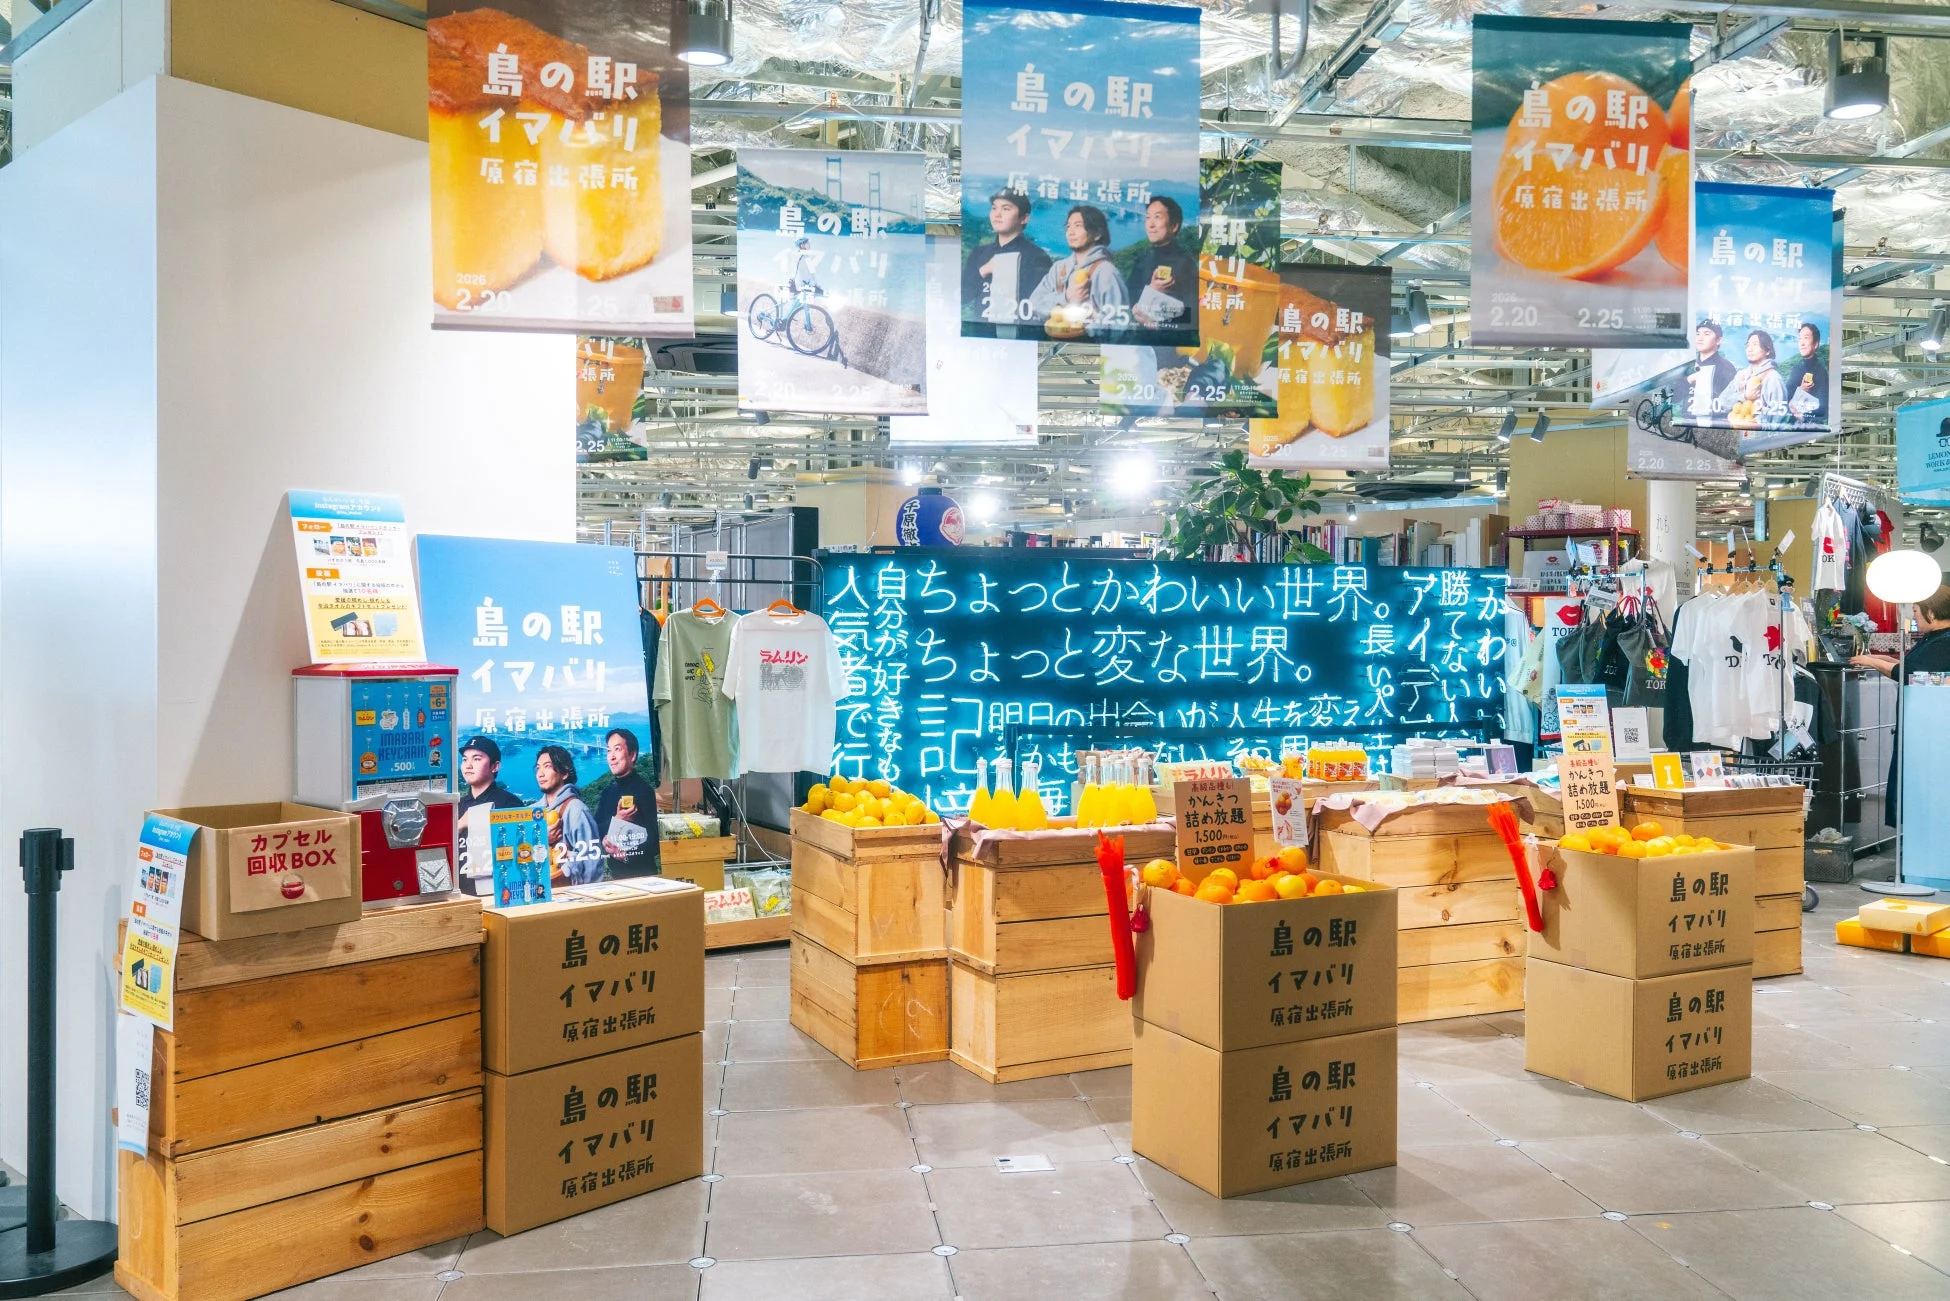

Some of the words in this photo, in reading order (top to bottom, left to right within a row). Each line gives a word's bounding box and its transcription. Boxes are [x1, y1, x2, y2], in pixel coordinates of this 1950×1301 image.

[482, 43, 638, 100] 島の駅
[1011, 63, 1153, 118] 島の駅
[1517, 80, 1648, 130] 島の駅
[478, 107, 638, 152] イマバリ
[1006, 124, 1154, 168] イマバリ
[1513, 140, 1650, 177] イマバリ
[480, 157, 638, 191] 原宿出張所
[1006, 172, 1152, 205] 原宿出張所
[1514, 186, 1650, 214] 原宿出張所
[776, 200, 888, 240] 島の駅
[1709, 229, 1804, 270] 島の駅
[456, 288, 512, 312] 2.20
[1281, 303, 1364, 334] 島の駅
[1490, 306, 1538, 327] 2.20
[1578, 308, 1624, 330] 2.25
[1709, 312, 1803, 330] 原宿出張所
[1278, 340, 1362, 364] イマバリ
[1278, 368, 1362, 386] 原宿出張所
[1116, 384, 1154, 400] 2.20
[1190, 385, 1226, 402] 2.25
[1262, 444, 1292, 457] 2.20
[1638, 458, 1664, 470] 2.20
[1686, 460, 1712, 472] 2.25
[917, 560, 1390, 622] ちょっとかわいい世界。
[472, 596, 604, 647] 島の駅
[760, 650, 808, 664] ラムリン
[916, 625, 1312, 685] ちょっと変な世界。
[471, 658, 606, 694] イマバリ
[476, 707, 610, 734] 原宿出張所
[381, 730, 425, 747] IMABARI
[379, 746, 427, 762] KEYCHAIN
[1568, 768, 1604, 780] かんきつ
[1188, 792, 1238, 808] かんきつ
[1568, 781, 1610, 798] 詰め放題
[1184, 808, 1246, 828] 詰め放題
[251, 830, 332, 852] カプセル
[554, 839, 602, 864] 2.25
[248, 848, 336, 876] 回収BOX
[1670, 872, 1729, 902] 島の駅
[1668, 910, 1726, 933] イマバリ
[562, 923, 660, 970] 島の駅
[1270, 918, 1357, 957] 島の駅
[1670, 938, 1726, 960] 原宿出張所
[560, 970, 656, 1008] イマバリ
[1268, 963, 1354, 994] イマバリ
[1270, 998, 1353, 1026] 原宿出張所
[1666, 988, 1725, 1024] 島の駅
[562, 1006, 656, 1042] 原宿出張所
[1665, 1026, 1722, 1053] イマバリ
[1268, 1060, 1356, 1103] 島の駅
[1666, 1056, 1722, 1081] 原宿出張所
[560, 1072, 658, 1126] 島の駅
[1266, 1106, 1352, 1139] イマバリ
[558, 1119, 655, 1164] イマバリ
[1269, 1140, 1352, 1172] 原宿出張所
[561, 1154, 656, 1198] 原宿出張所
